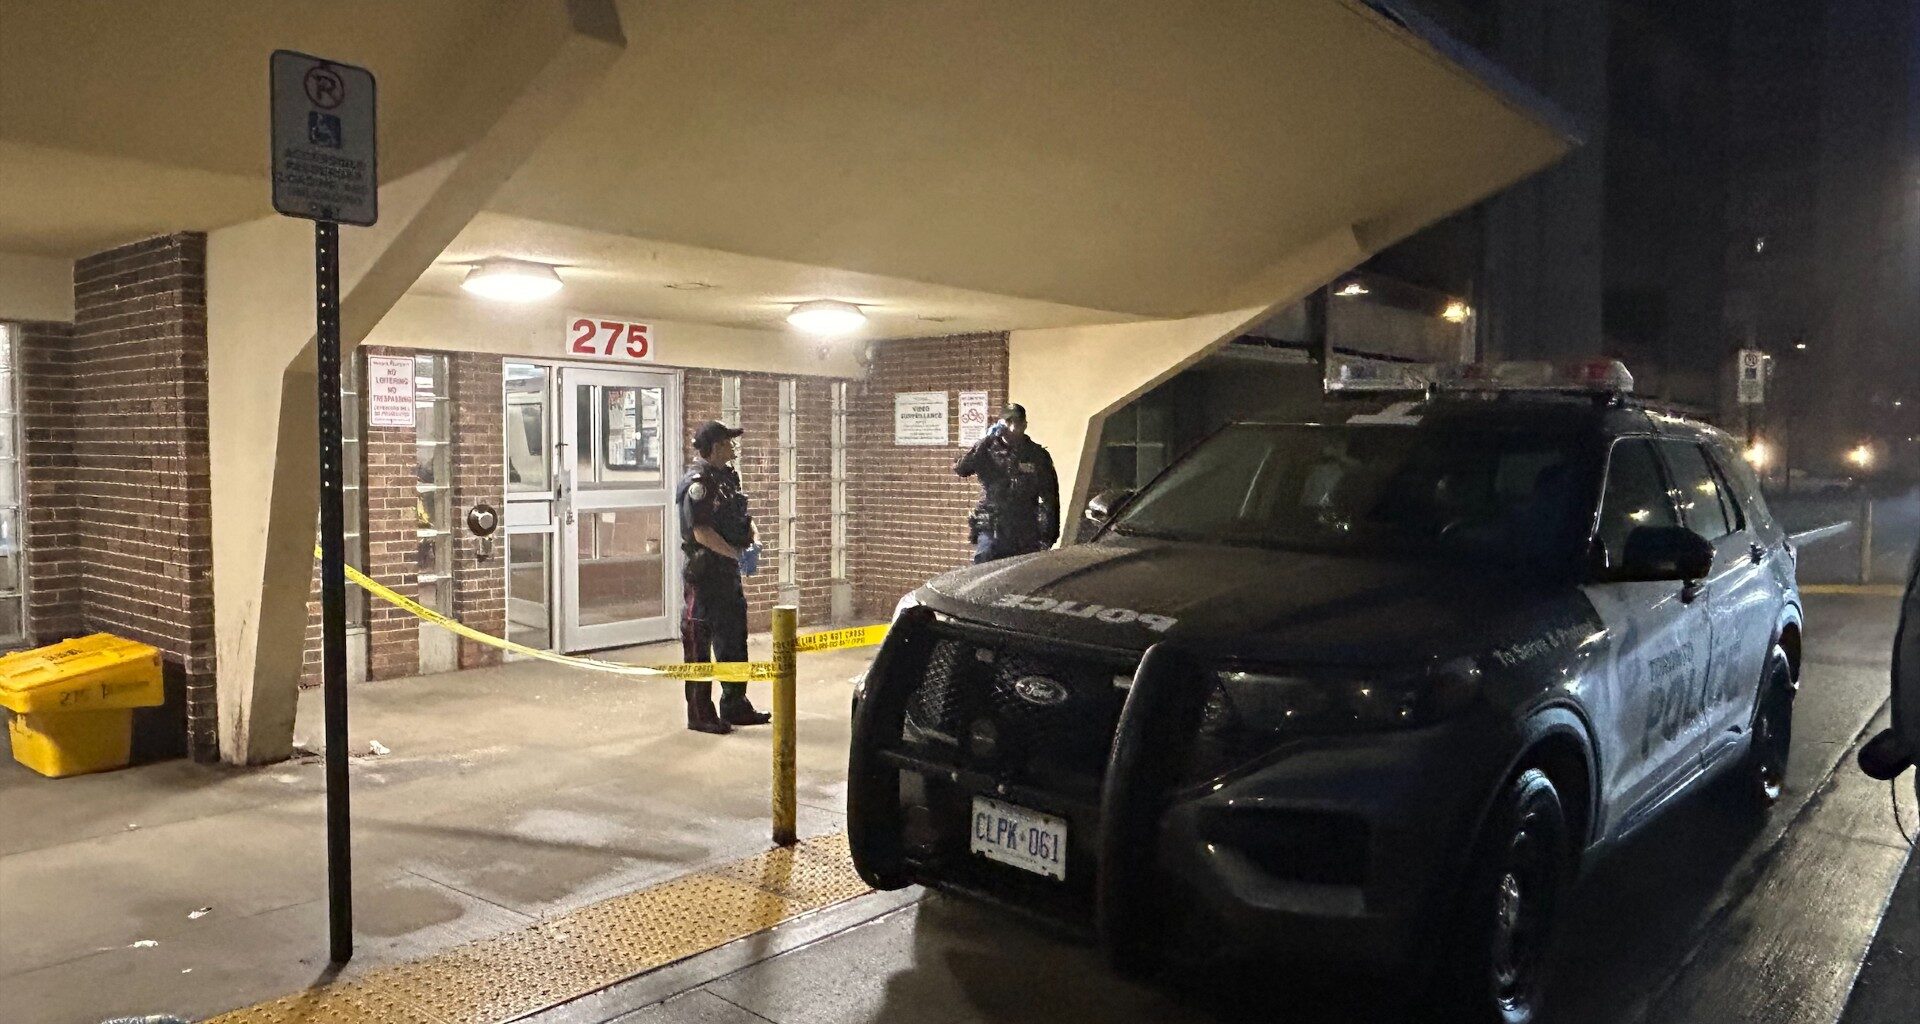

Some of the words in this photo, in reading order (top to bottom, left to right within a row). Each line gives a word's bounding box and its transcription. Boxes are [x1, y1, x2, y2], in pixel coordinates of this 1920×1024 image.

[572, 319, 648, 358] 275
[989, 593, 1178, 632] POLICE
[819, 634, 828, 642] DO
[831, 631, 842, 640] NOT
[845, 629, 865, 639] CROSS
[976, 812, 1018, 850] CLPK
[1028, 828, 1059, 863] 061
